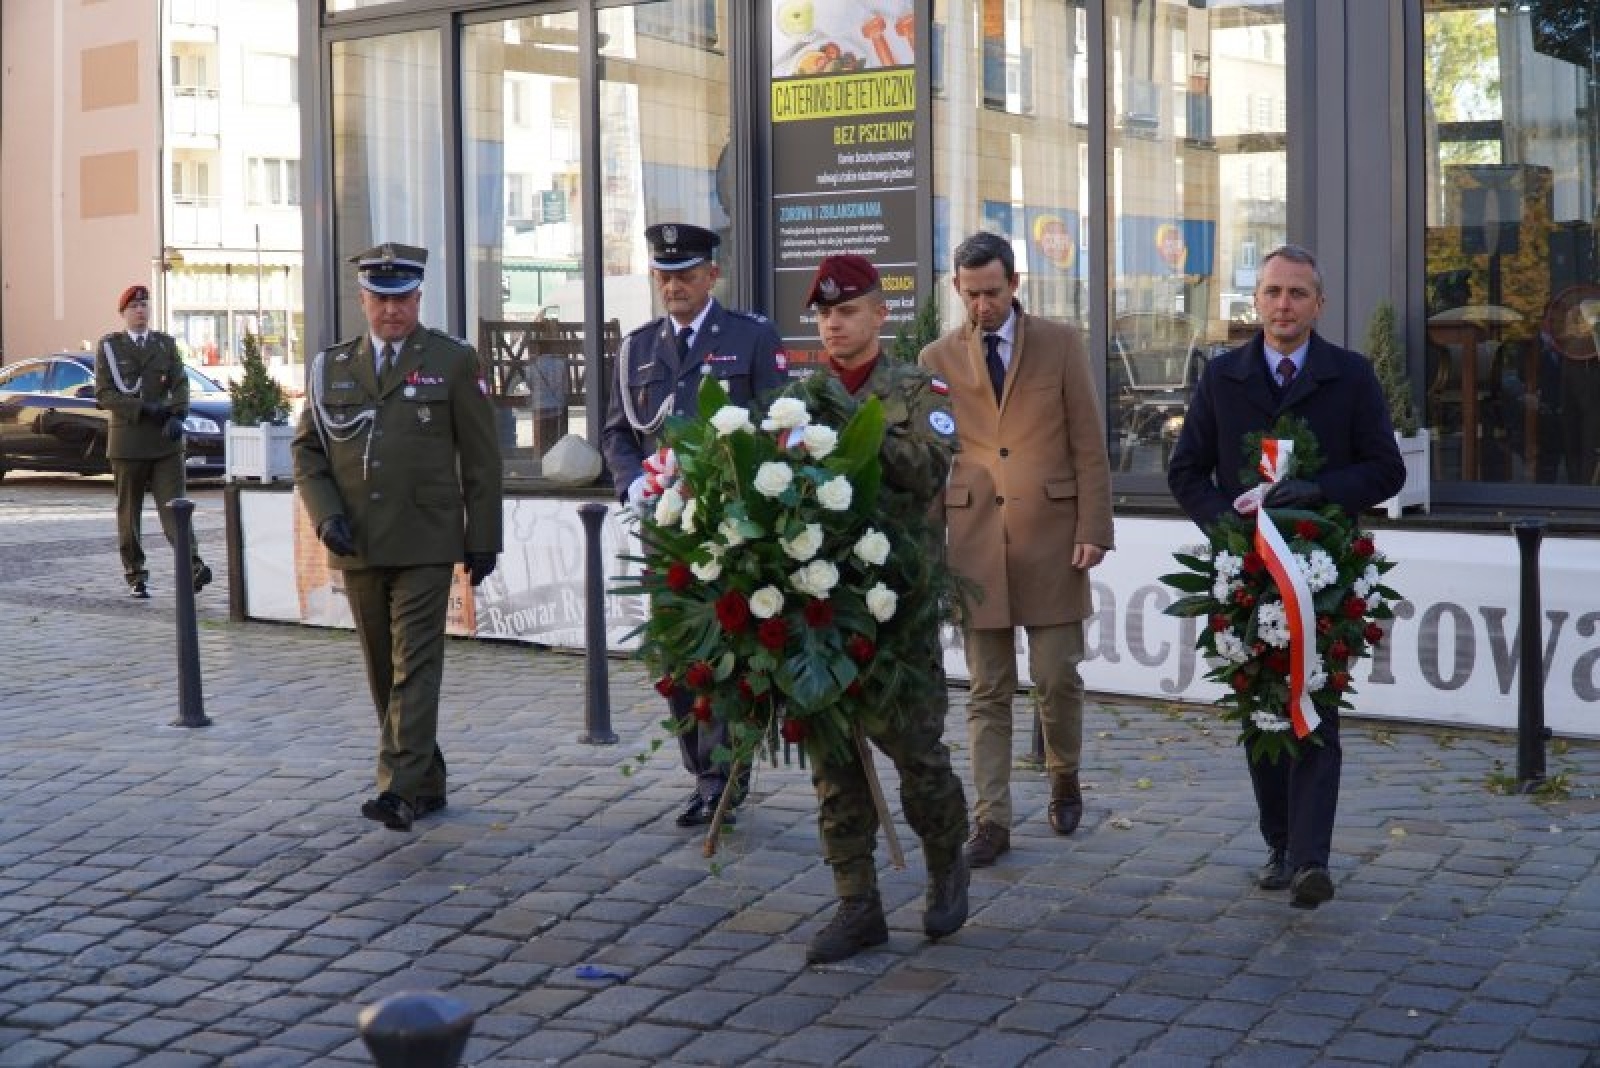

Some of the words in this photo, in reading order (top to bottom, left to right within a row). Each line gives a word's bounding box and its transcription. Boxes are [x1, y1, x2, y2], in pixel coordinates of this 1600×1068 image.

[775, 82, 833, 117] CATERING
[834, 75, 915, 111] DIETETYCZNY
[833, 125, 855, 145] BEZ
[858, 121, 915, 143] PSZENICY
[488, 600, 557, 636] Browar
